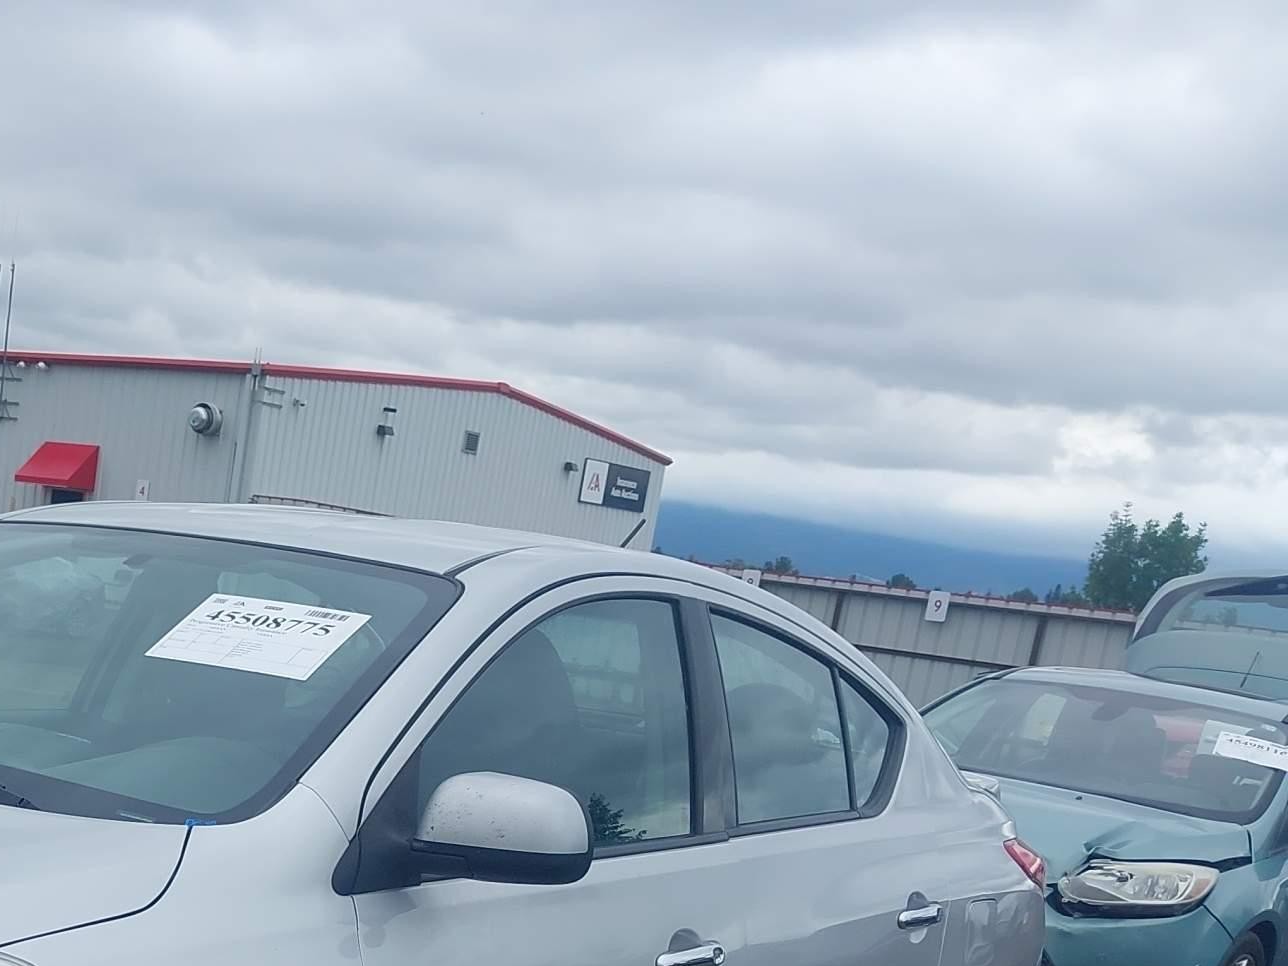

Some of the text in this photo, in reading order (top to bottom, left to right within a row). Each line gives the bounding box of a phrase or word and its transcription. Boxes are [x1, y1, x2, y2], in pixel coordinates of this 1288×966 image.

[138, 486, 145, 497] 4
[934, 599, 942, 613] 9
[206, 609, 336, 637] 45508775
